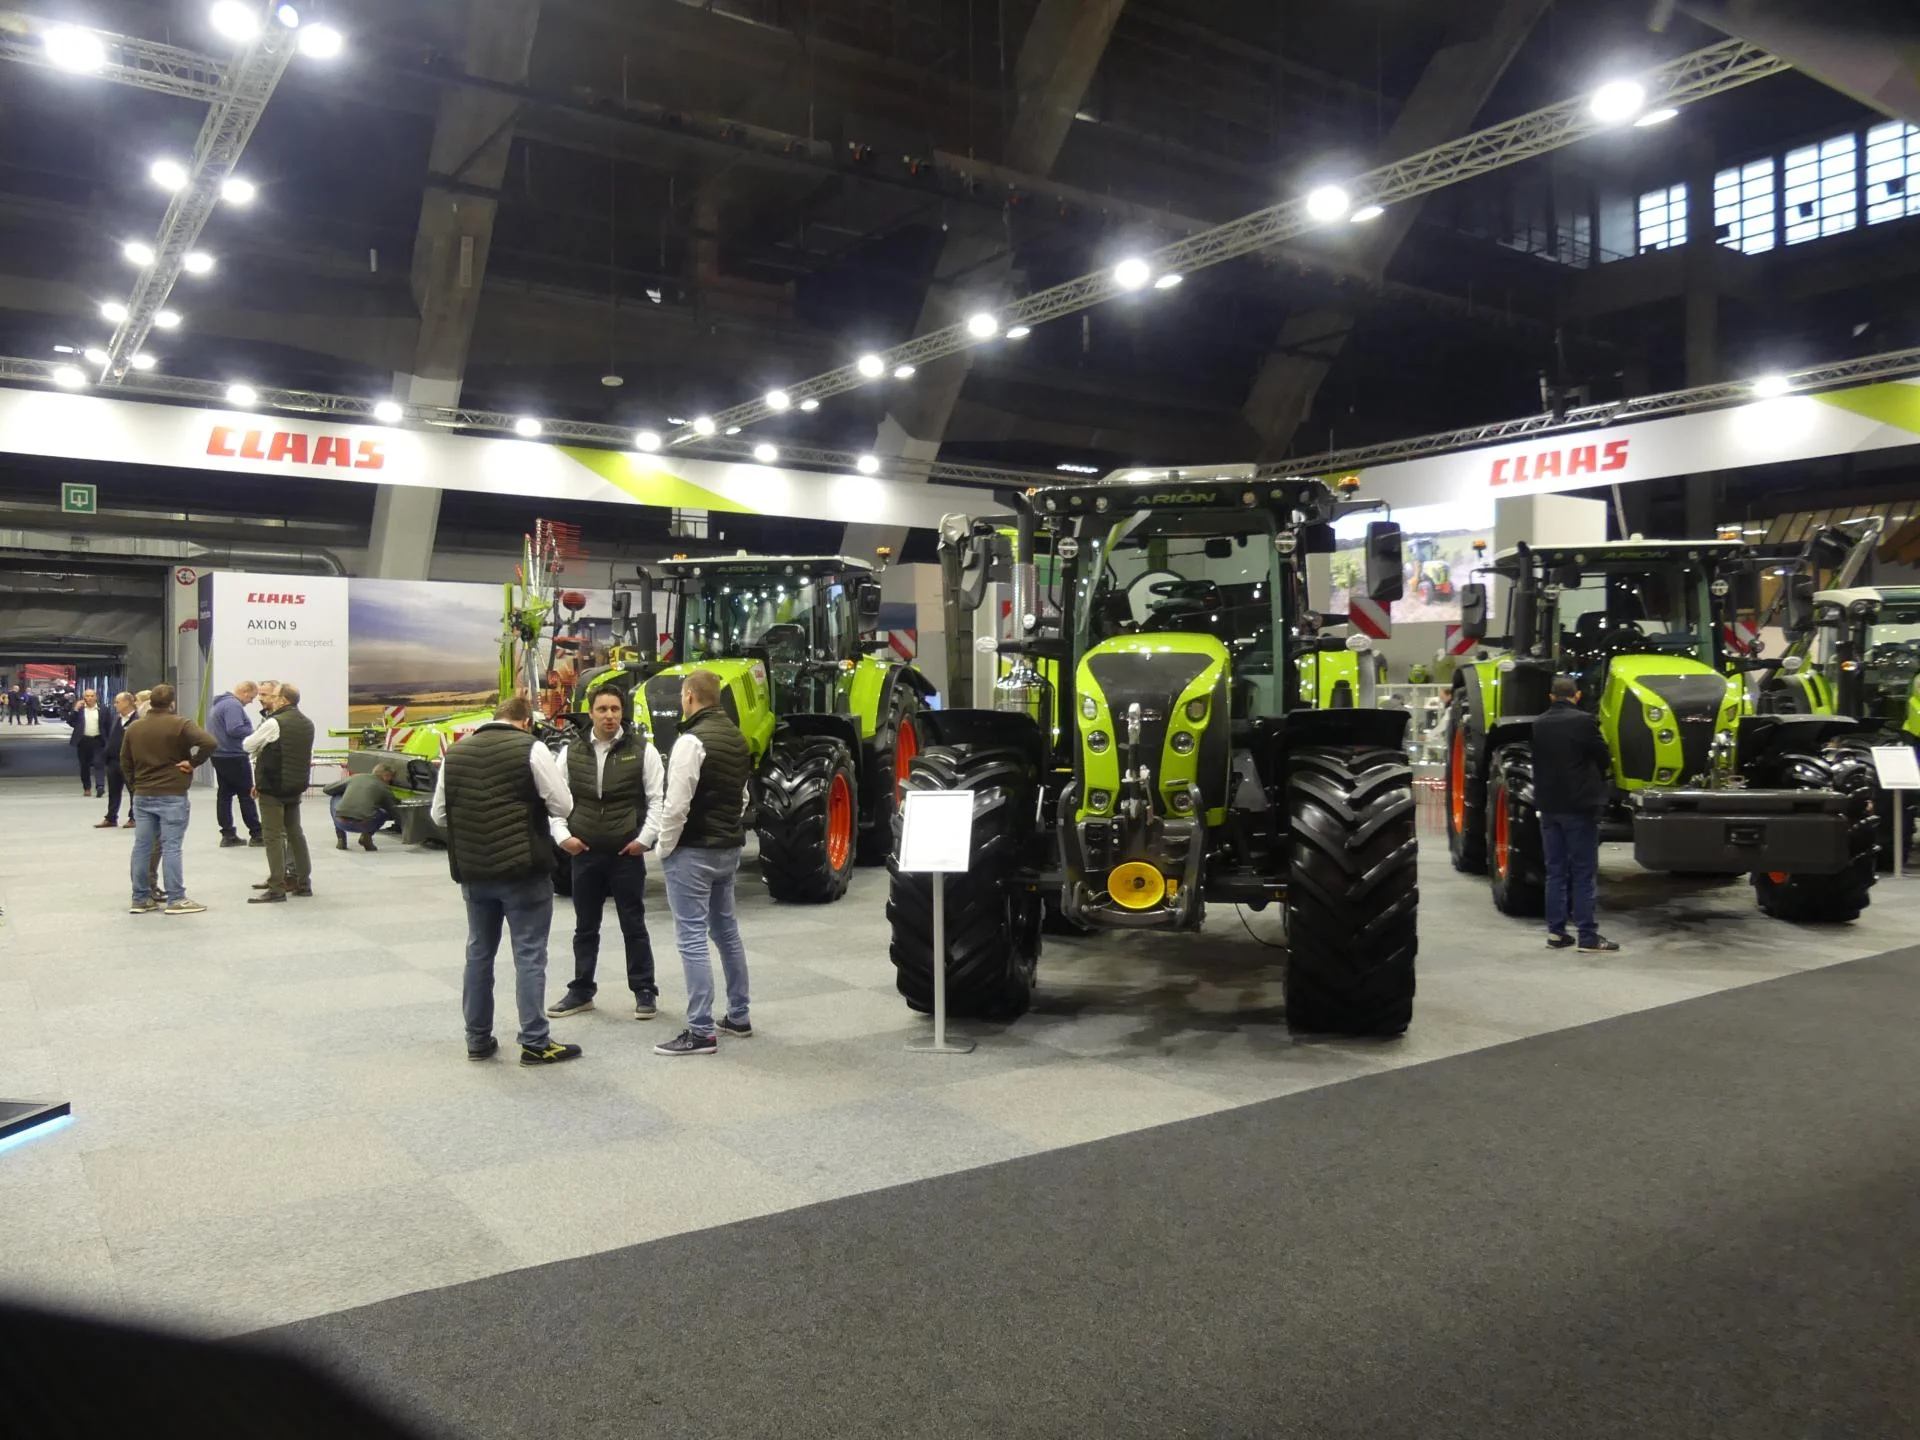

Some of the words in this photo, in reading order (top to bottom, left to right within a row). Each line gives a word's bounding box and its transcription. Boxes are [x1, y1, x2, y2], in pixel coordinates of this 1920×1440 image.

[206, 425, 386, 470] CLAAS
[1489, 439, 1630, 487] CLAAS
[1131, 492, 1217, 505] ARION
[247, 592, 306, 604] CLAAS
[247, 619, 287, 630] AXION
[289, 620, 298, 630] 9
[247, 636, 291, 649] Challenge
